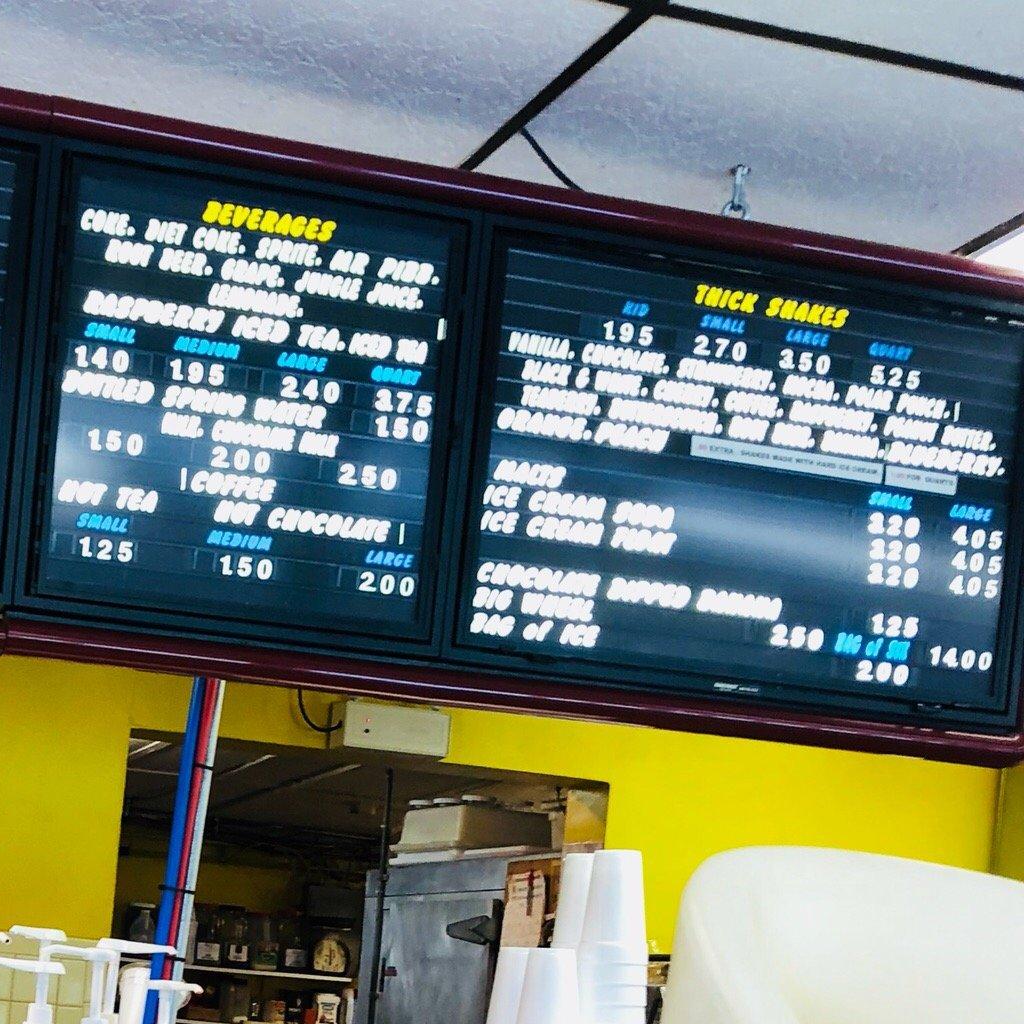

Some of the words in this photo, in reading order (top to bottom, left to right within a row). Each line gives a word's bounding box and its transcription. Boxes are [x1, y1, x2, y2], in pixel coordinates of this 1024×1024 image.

[203, 200, 336, 242] BEVERAGES
[104, 239, 154, 266] ROOT
[294, 270, 363, 301] JUNGLE
[144, 219, 188, 246] DIET
[330, 248, 370, 275] MR
[83, 290, 225, 333] RASPBERRY
[231, 315, 290, 343] ICED
[348, 333, 392, 359] ICED
[695, 284, 758, 314] THICK
[765, 296, 850, 329] SHAKES
[84, 322, 136, 344] SMALL
[174, 335, 241, 360] MEDIUM
[277, 351, 329, 373] LARGE
[371, 365, 422, 386] QUART
[621, 302, 650, 318] KID
[700, 314, 745, 334] SMALL
[785, 328, 830, 348] LARGE
[868, 342, 913, 361] QUART
[521, 359, 572, 387] BLACK
[575, 367, 590, 389] &
[62, 370, 155, 405] BOTTLED
[161, 386, 246, 418] SPRING
[254, 397, 327, 429] WATER
[190, 472, 276, 502] COFFEE
[493, 459, 567, 488] MALTS
[58, 478, 107, 505] HOT
[118, 487, 158, 513] TEA
[213, 500, 260, 526] HOT
[267, 508, 391, 544] CHOCOLATE
[482, 484, 522, 508] ICE
[527, 489, 607, 521] CREAM
[612, 501, 675, 530] SODA
[868, 491, 912, 511] SMALL
[949, 504, 994, 522] LARGE
[76, 512, 129, 534] SMALL
[206, 530, 273, 552] MEDIUM
[364, 549, 414, 569] LARGE
[480, 510, 520, 534] ICE
[525, 515, 605, 547] CREAM
[610, 526, 677, 555] FLOAT
[473, 587, 514, 611] BIG
[521, 592, 595, 622] WHEEL
[477, 562, 601, 597] CHOCOLATE
[607, 577, 691, 610] DIPPED
[470, 612, 516, 637] BAG
[523, 620, 554, 642] of
[560, 624, 601, 648] ICE
